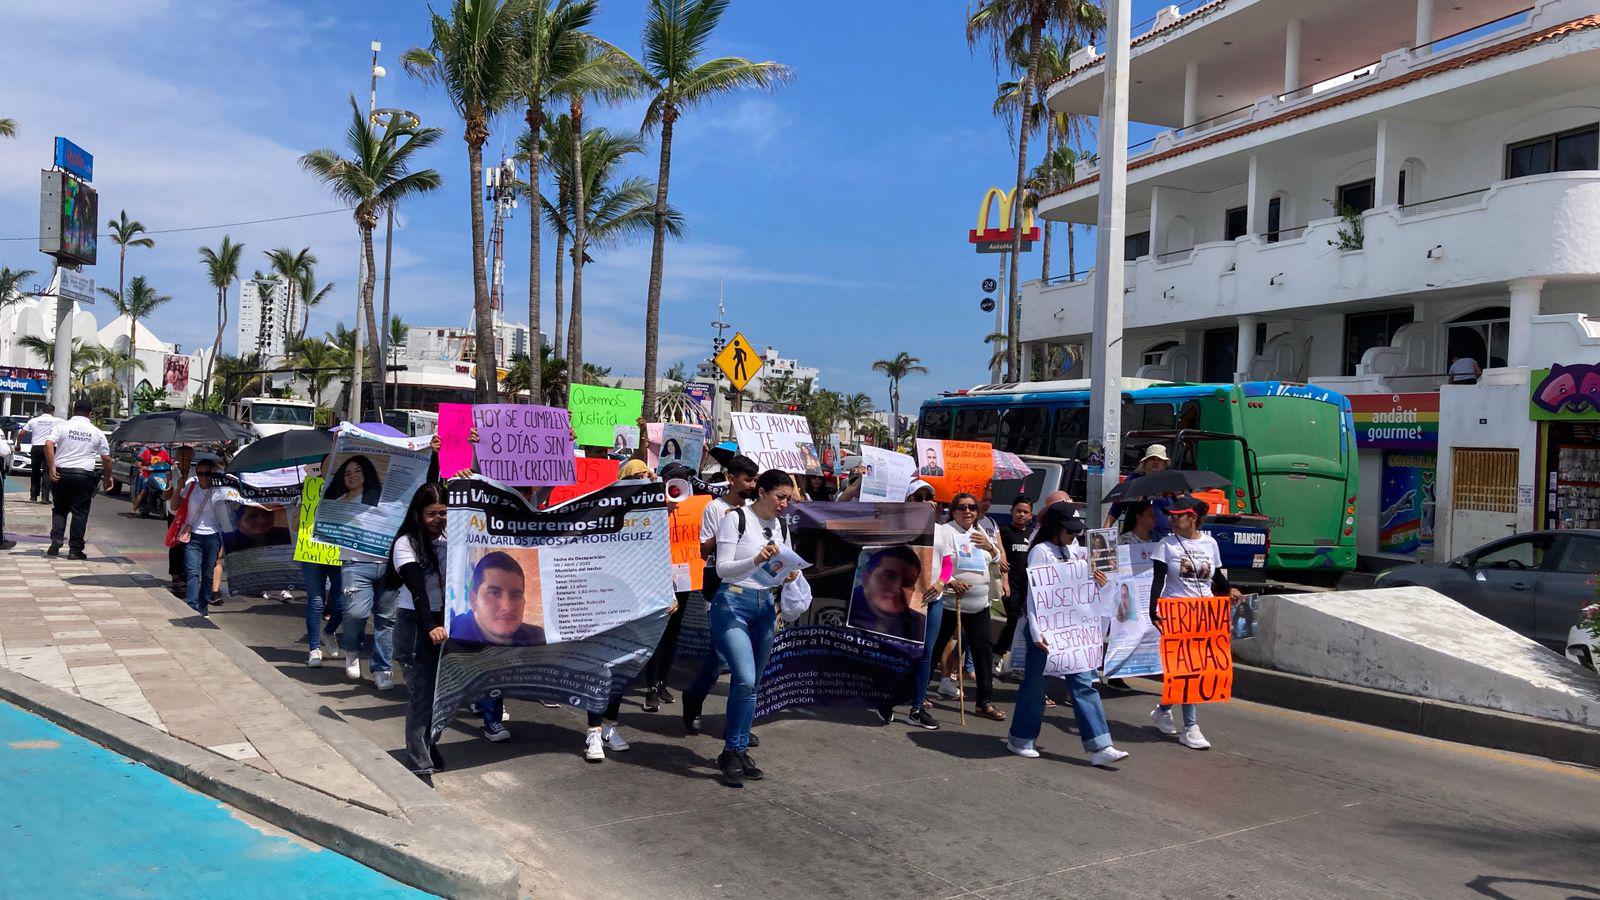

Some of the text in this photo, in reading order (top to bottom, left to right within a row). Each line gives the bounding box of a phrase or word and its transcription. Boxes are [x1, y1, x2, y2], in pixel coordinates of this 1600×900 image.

[572, 388, 626, 408] Queremos
[474, 409, 570, 430] HOY SE CUMPLEN
[733, 414, 810, 436] TUS PRIMAS
[491, 430, 565, 456] 8 DÍAS SIN
[755, 432, 778, 450] TE
[1368, 426, 1422, 442] gourmet
[478, 458, 518, 482] CECILIA
[524, 459, 576, 482] CRISTINA
[631, 491, 665, 506] vivo
[490, 516, 616, 532] lo queremos!!!
[465, 531, 654, 546] JUAN CARLOS ACOSTA RODRÍGUEZ
[1234, 532, 1266, 545] TRANSITO
[1066, 562, 1084, 582] TU
[1036, 582, 1100, 610] AUSENCIA
[1159, 599, 1230, 635] HERMANA
[770, 638, 807, 654] trabajar
[820, 636, 830, 646] la
[834, 642, 859, 654] casa
[856, 637, 880, 649] tras
[1054, 625, 1102, 650] ESPERANZA
[770, 655, 782, 663] de
[1045, 648, 1084, 673] SIGUE
[1164, 634, 1230, 673] FALTAS
[798, 670, 819, 680] pide
[766, 680, 814, 695] desapareció
[772, 693, 778, 701] la
[765, 707, 770, 716] y
[770, 696, 814, 711] reparación
